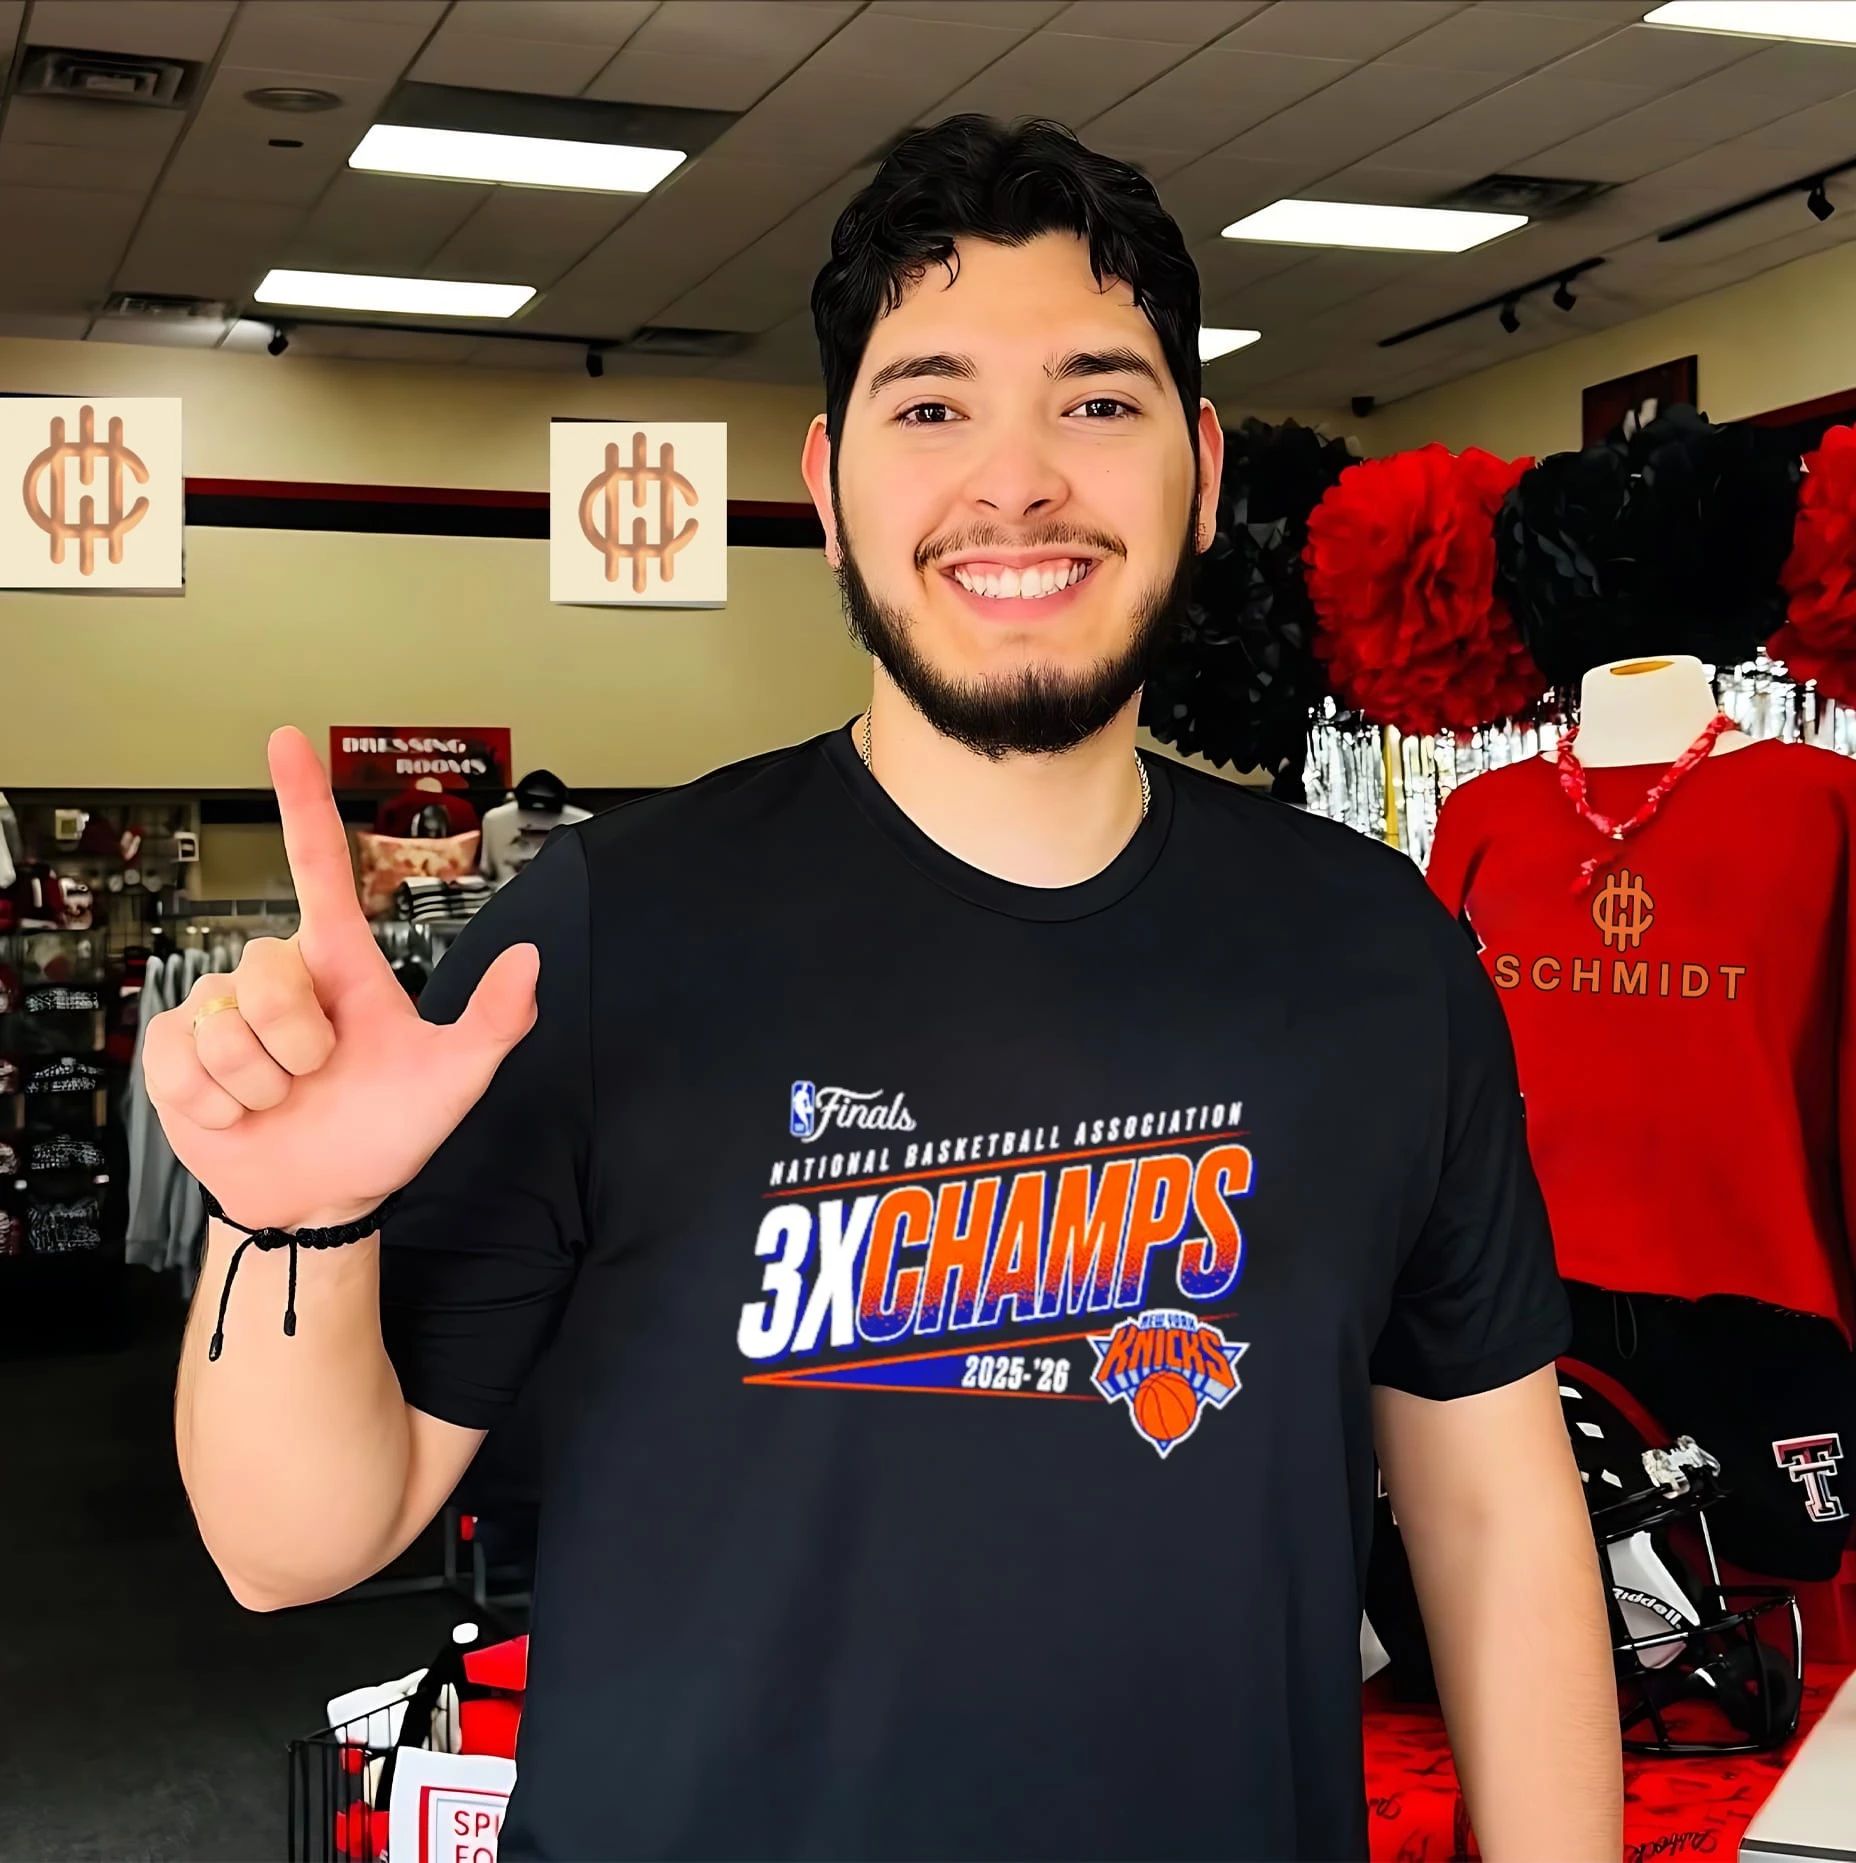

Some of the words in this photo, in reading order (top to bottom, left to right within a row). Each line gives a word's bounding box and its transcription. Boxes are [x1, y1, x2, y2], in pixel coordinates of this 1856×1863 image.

[396, 758, 487, 774] ROOMS
[1495, 954, 1746, 999] SCHMIDT
[801, 1086, 917, 1143] Finals
[769, 1147, 890, 1186] NATIONAL
[904, 1126, 1060, 1169] BASKETBALL
[1073, 1101, 1243, 1146] ASSOCIATION
[1140, 1313, 1166, 1329] NEW
[1168, 1313, 1197, 1330] YORK
[1097, 1323, 1236, 1390] KNICKS
